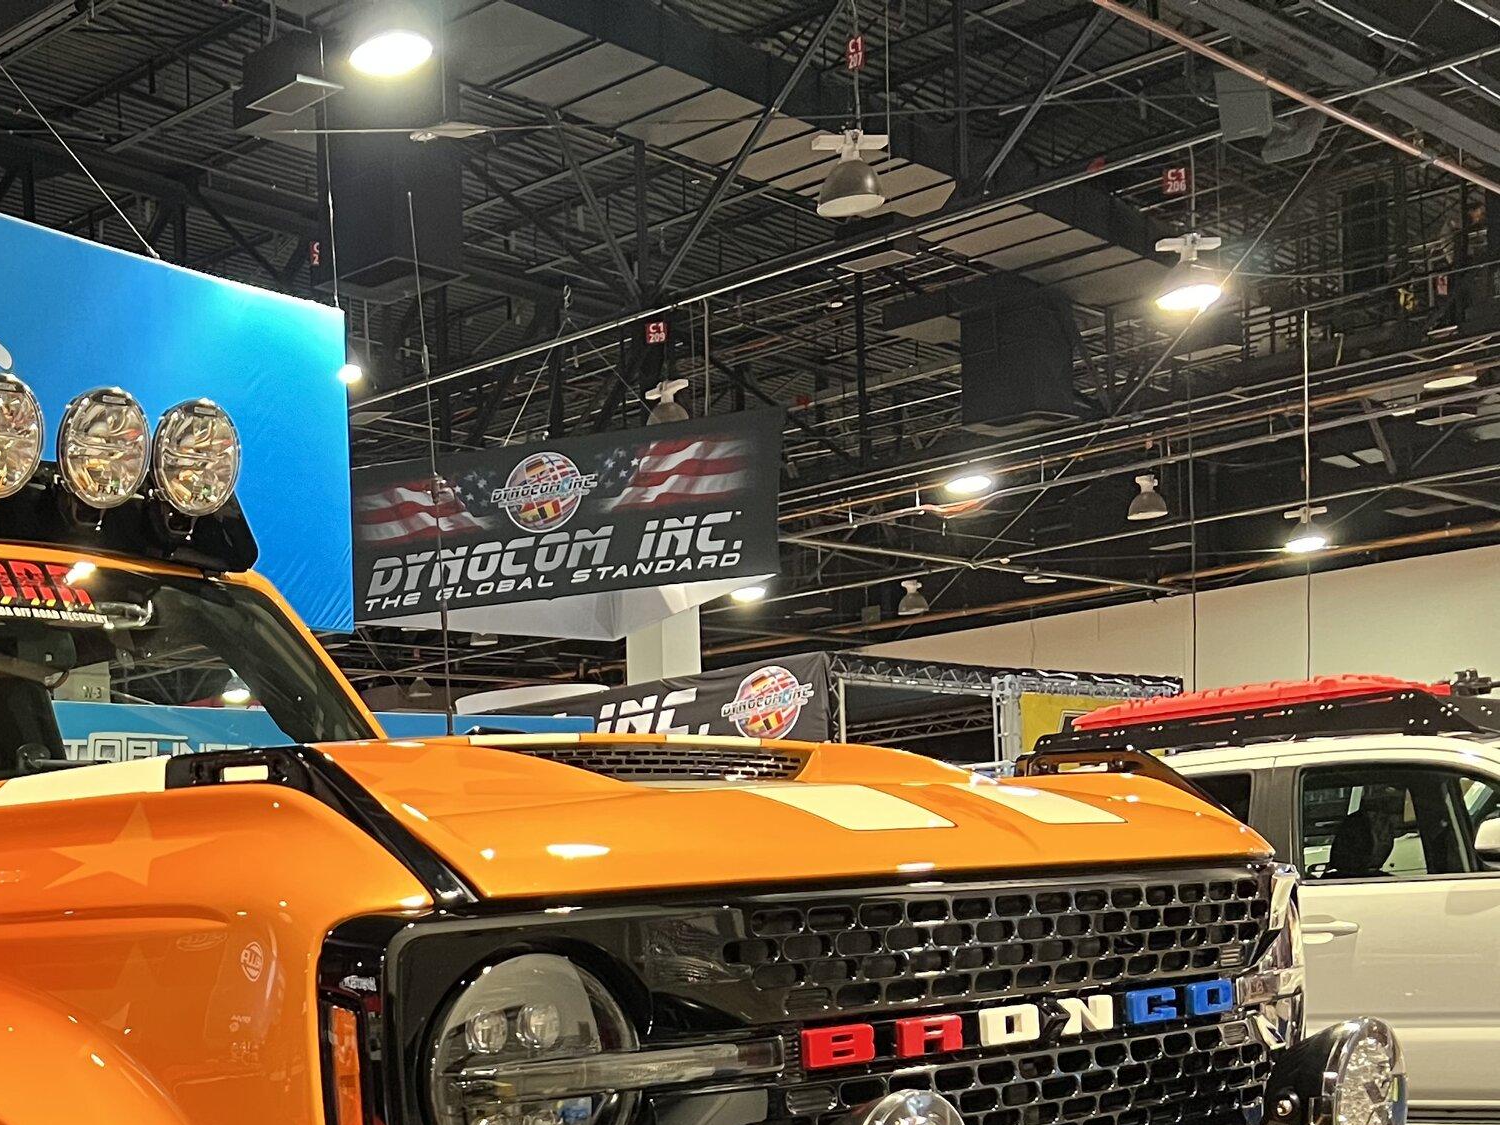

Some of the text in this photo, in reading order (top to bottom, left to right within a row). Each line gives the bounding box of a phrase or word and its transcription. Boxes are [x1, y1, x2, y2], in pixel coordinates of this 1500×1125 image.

[1166, 167, 1186, 180] C1
[649, 321, 664, 333] C1
[364, 552, 741, 612] THE GLOBAL STANDARD
[367, 511, 743, 599] DYNOCOM INC.
[802, 978, 1234, 1069] BRONCO
